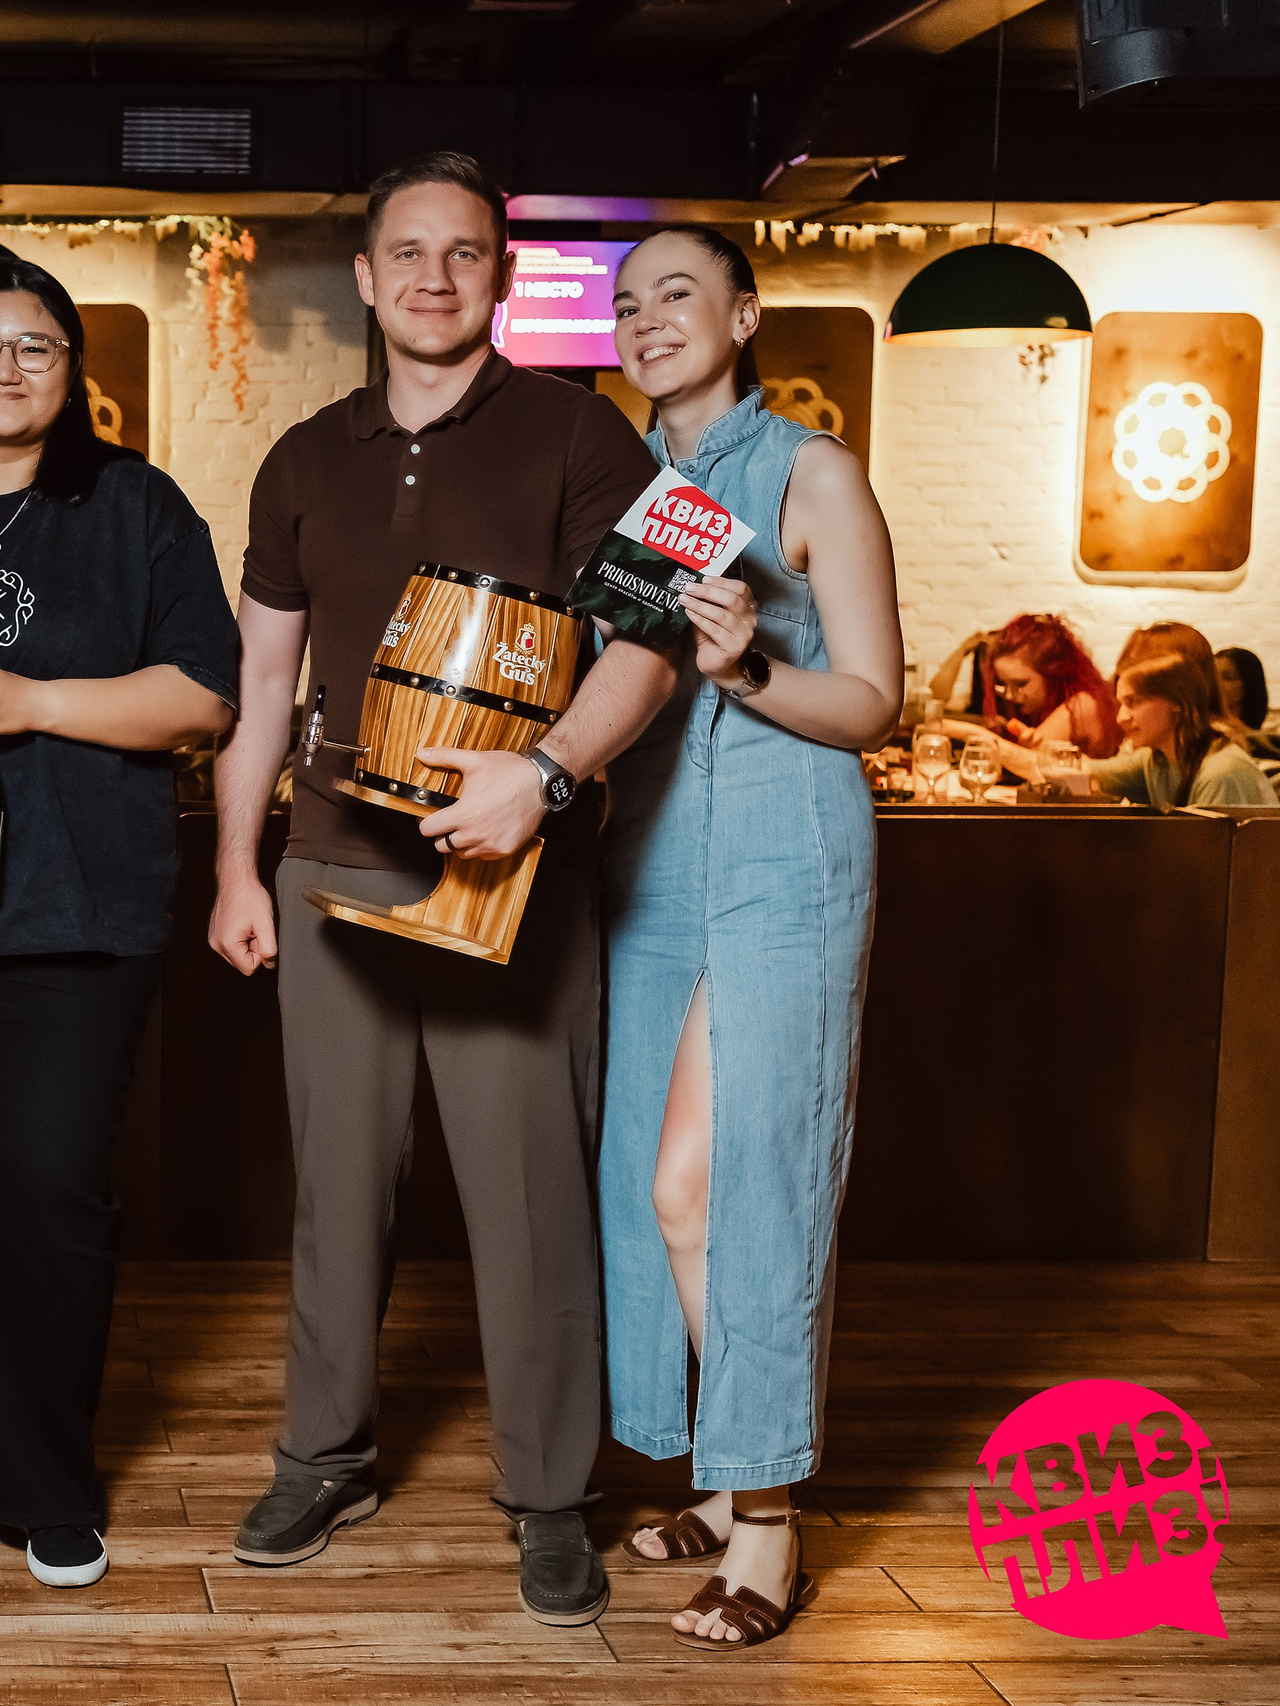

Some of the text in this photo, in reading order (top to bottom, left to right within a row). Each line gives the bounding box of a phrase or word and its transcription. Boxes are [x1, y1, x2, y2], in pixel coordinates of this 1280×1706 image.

[643, 517, 725, 563] ПЛИЗ!
[652, 494, 730, 543] КВИЗ,
[597, 561, 680, 613] PRIKOSNOVENIE
[492, 641, 546, 674] Žatecký
[499, 661, 536, 686] Gus
